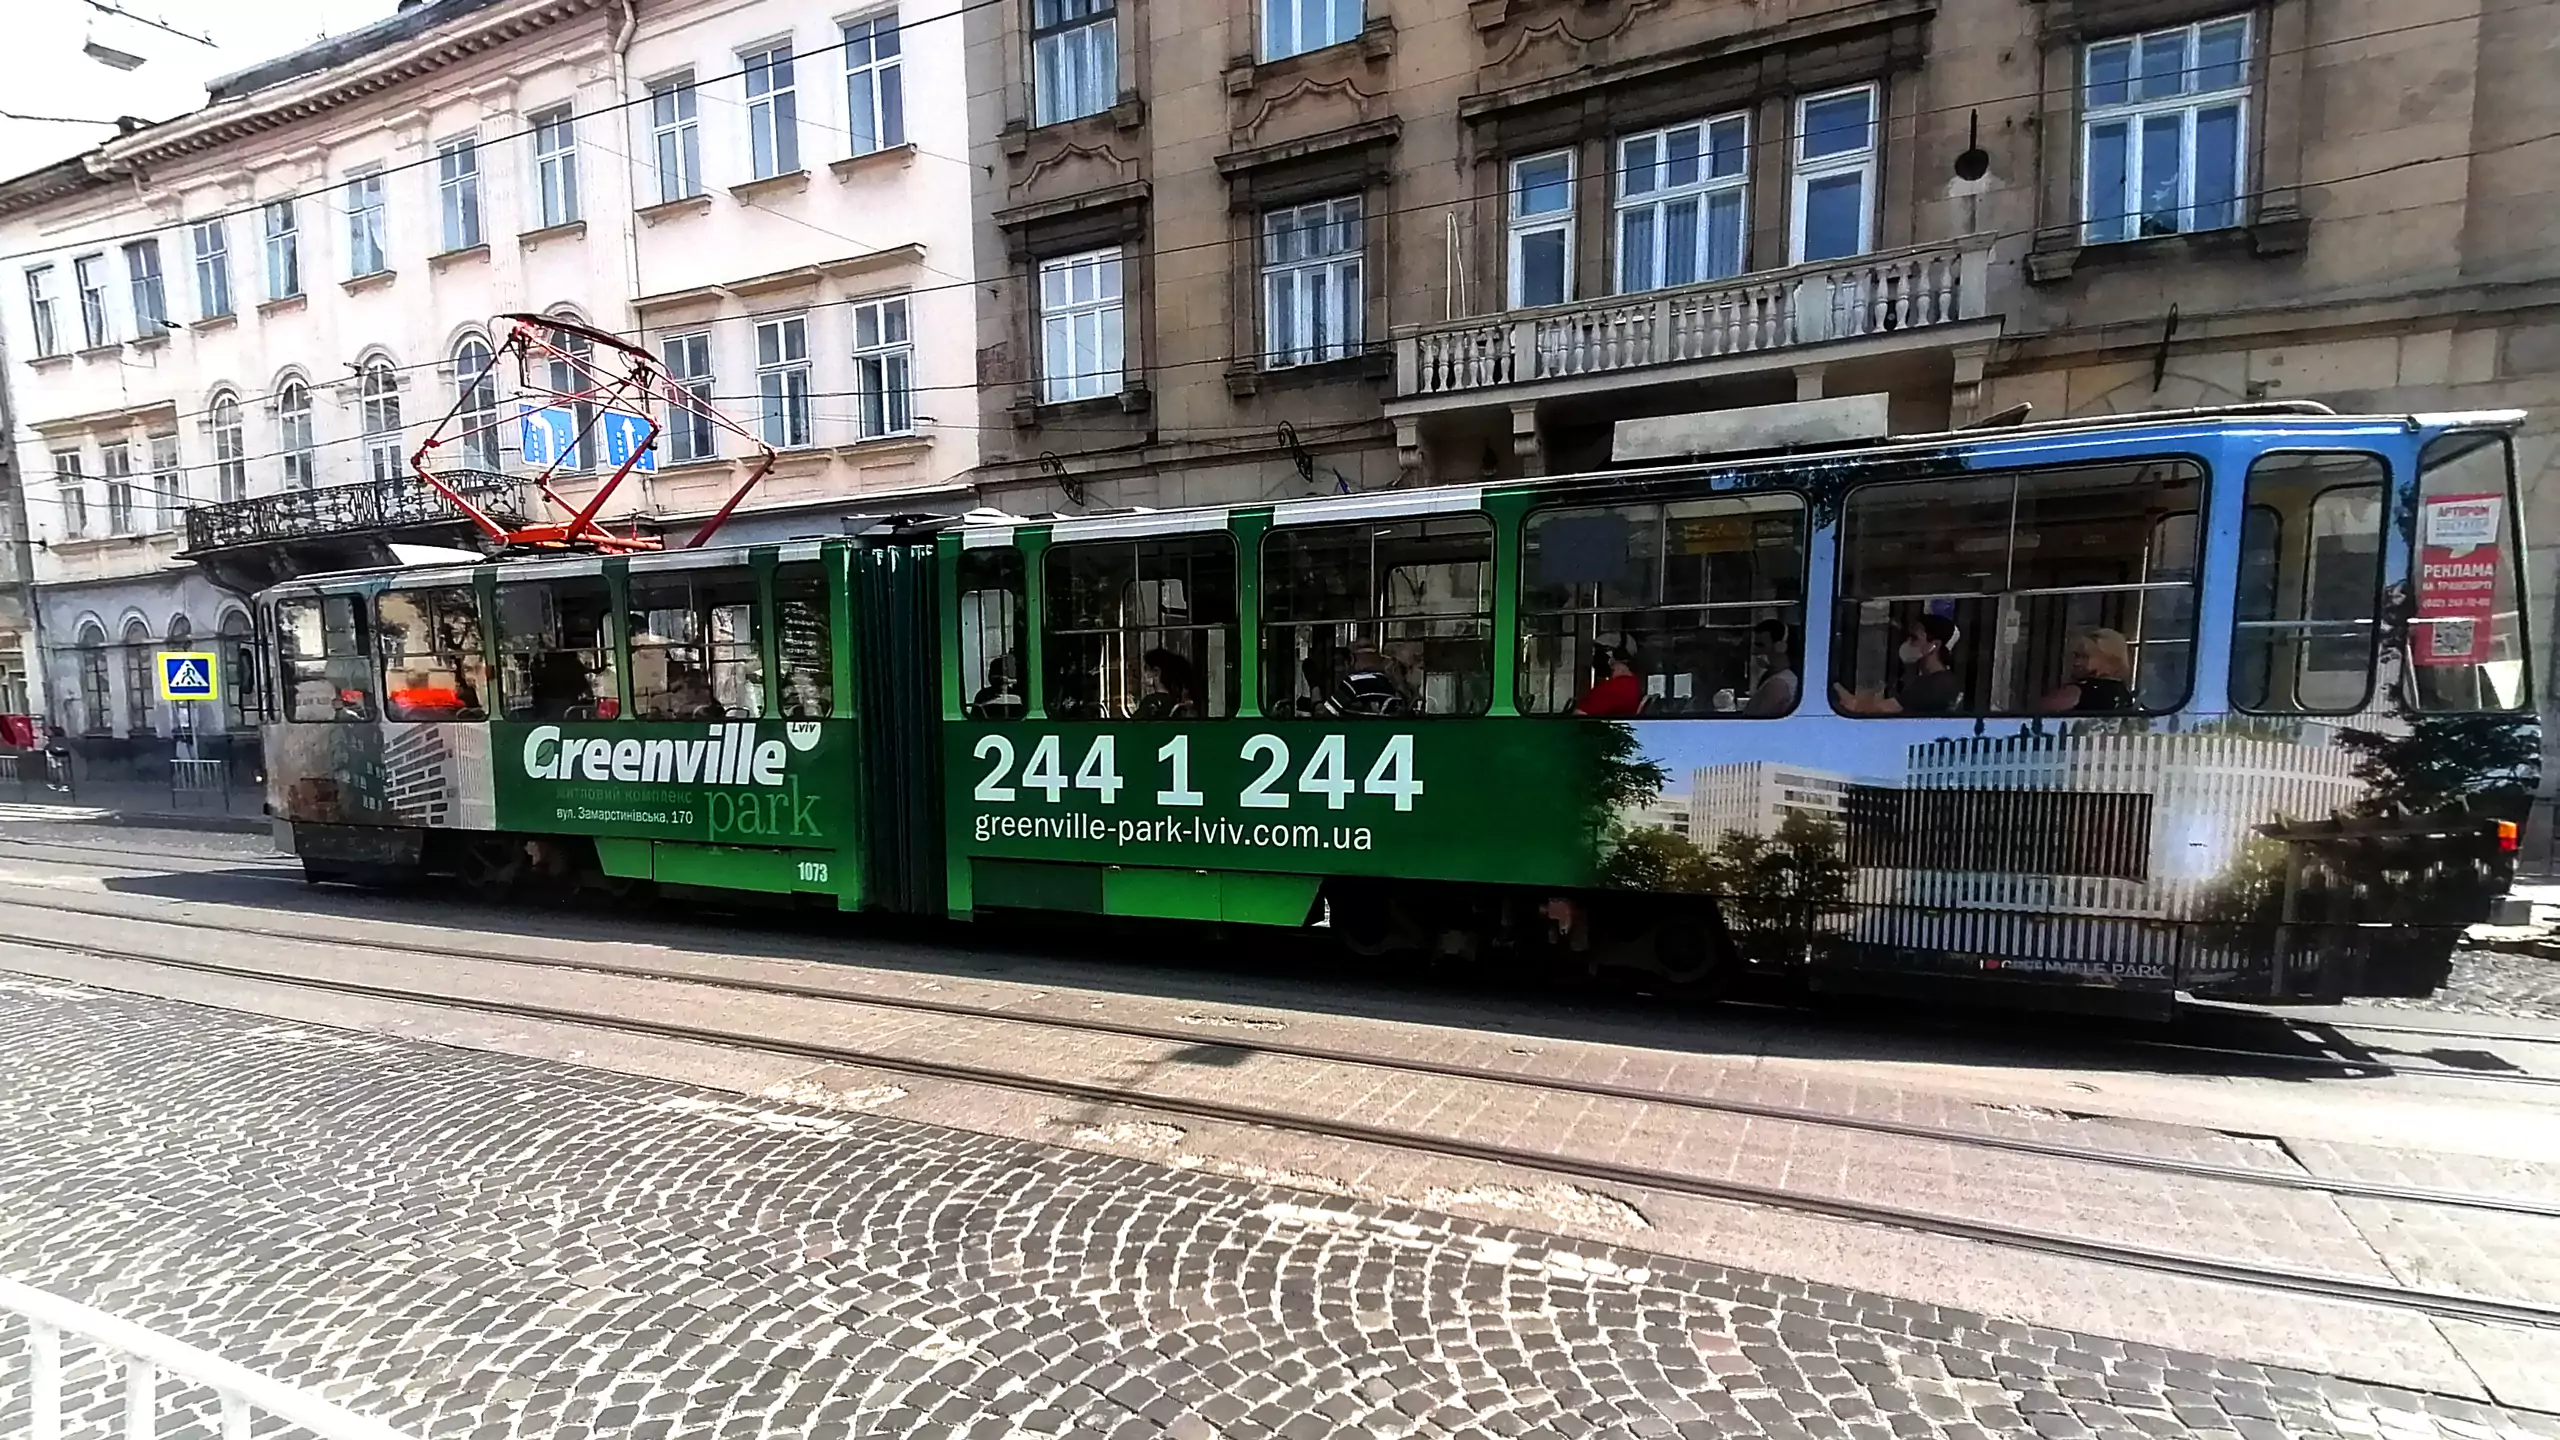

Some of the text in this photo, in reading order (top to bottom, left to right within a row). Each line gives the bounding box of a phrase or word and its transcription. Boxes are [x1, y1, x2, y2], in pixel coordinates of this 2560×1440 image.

[2423, 563, 2495, 579] РЕКЛАМА
[792, 722, 817, 733] Lviv
[523, 722, 787, 786] Greenville
[972, 733, 1425, 813] 244 1 244
[625, 788, 693, 805] комплекс
[556, 806, 694, 825] вул. Замарстинівська, 170
[704, 774, 824, 855] park
[975, 812, 1373, 850] greenville-park-lviv.com.ua
[797, 861, 829, 882] 1073
[2111, 963, 2167, 979] PARK
